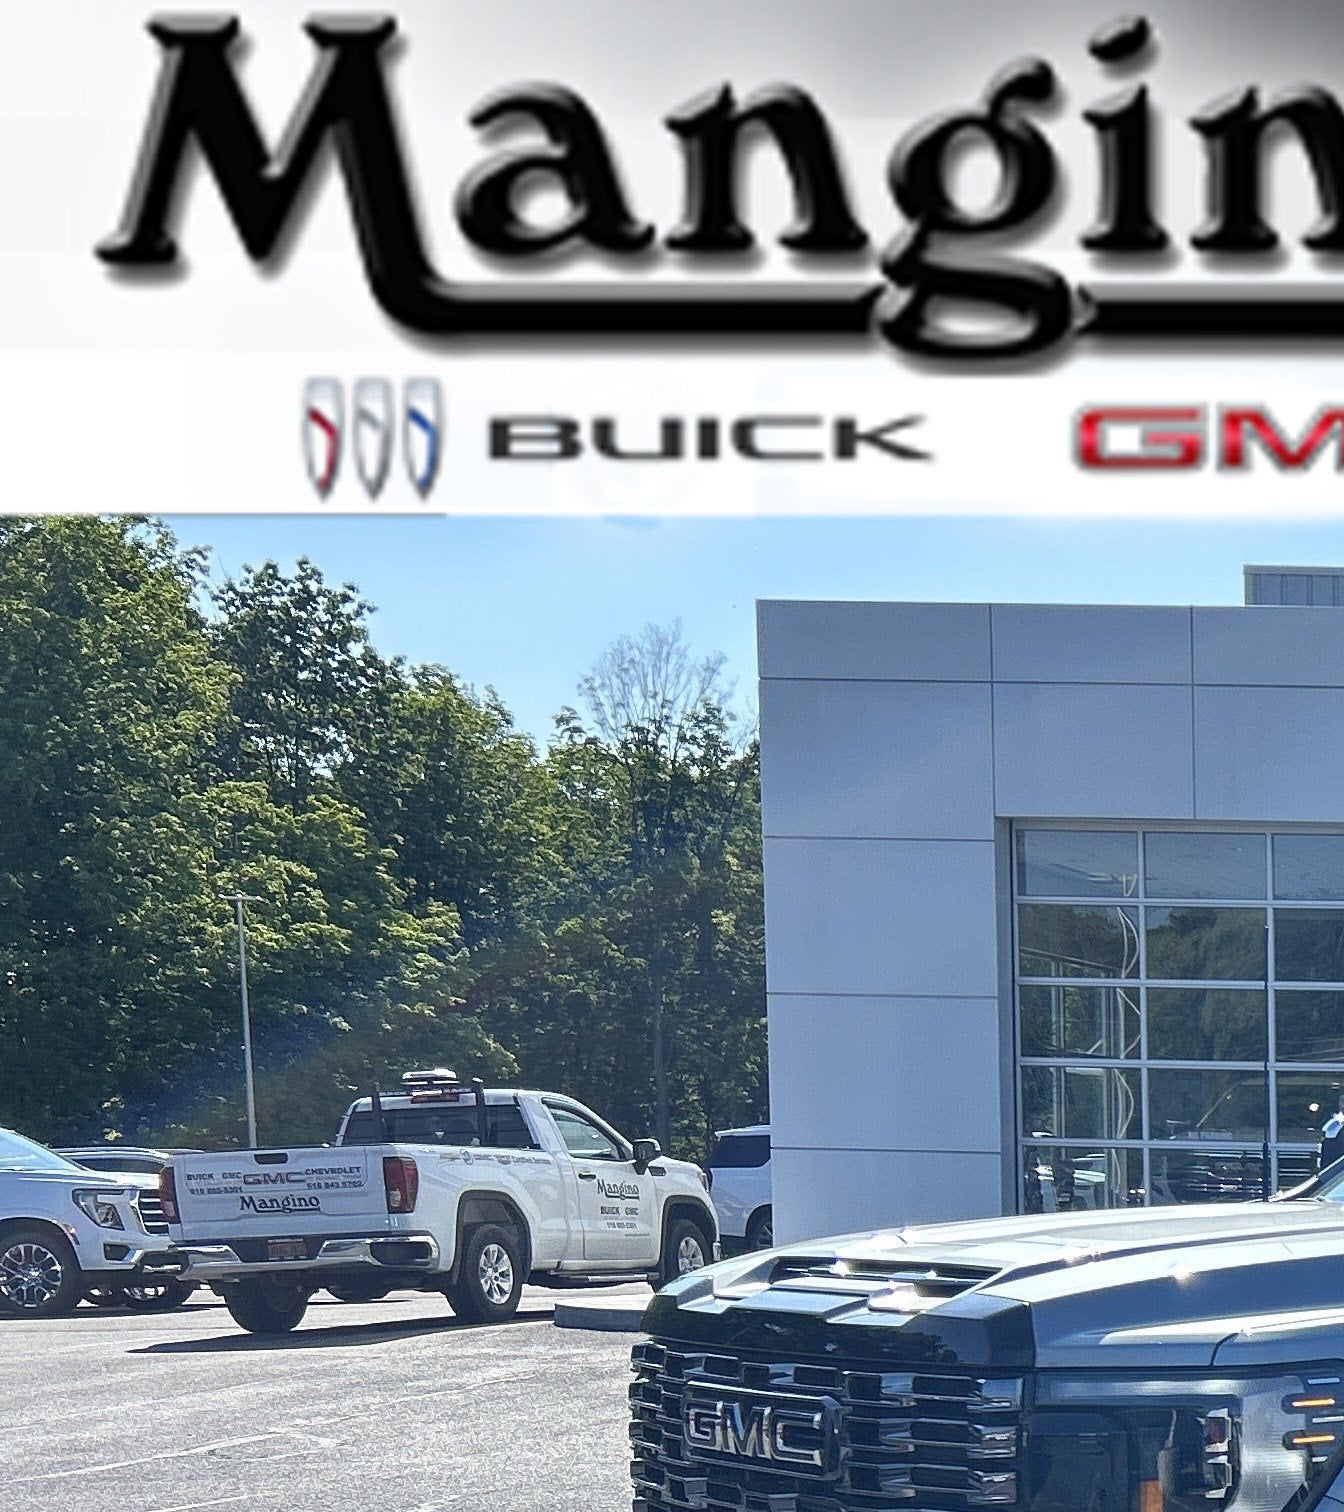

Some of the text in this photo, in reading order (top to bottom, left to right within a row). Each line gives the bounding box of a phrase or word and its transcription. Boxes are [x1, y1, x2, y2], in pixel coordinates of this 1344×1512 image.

[243, 1171, 306, 1185] GMC
[598, 1179, 640, 1200] Mangino
[240, 1194, 321, 1213] Mangino
[684, 1400, 823, 1467] GMC
